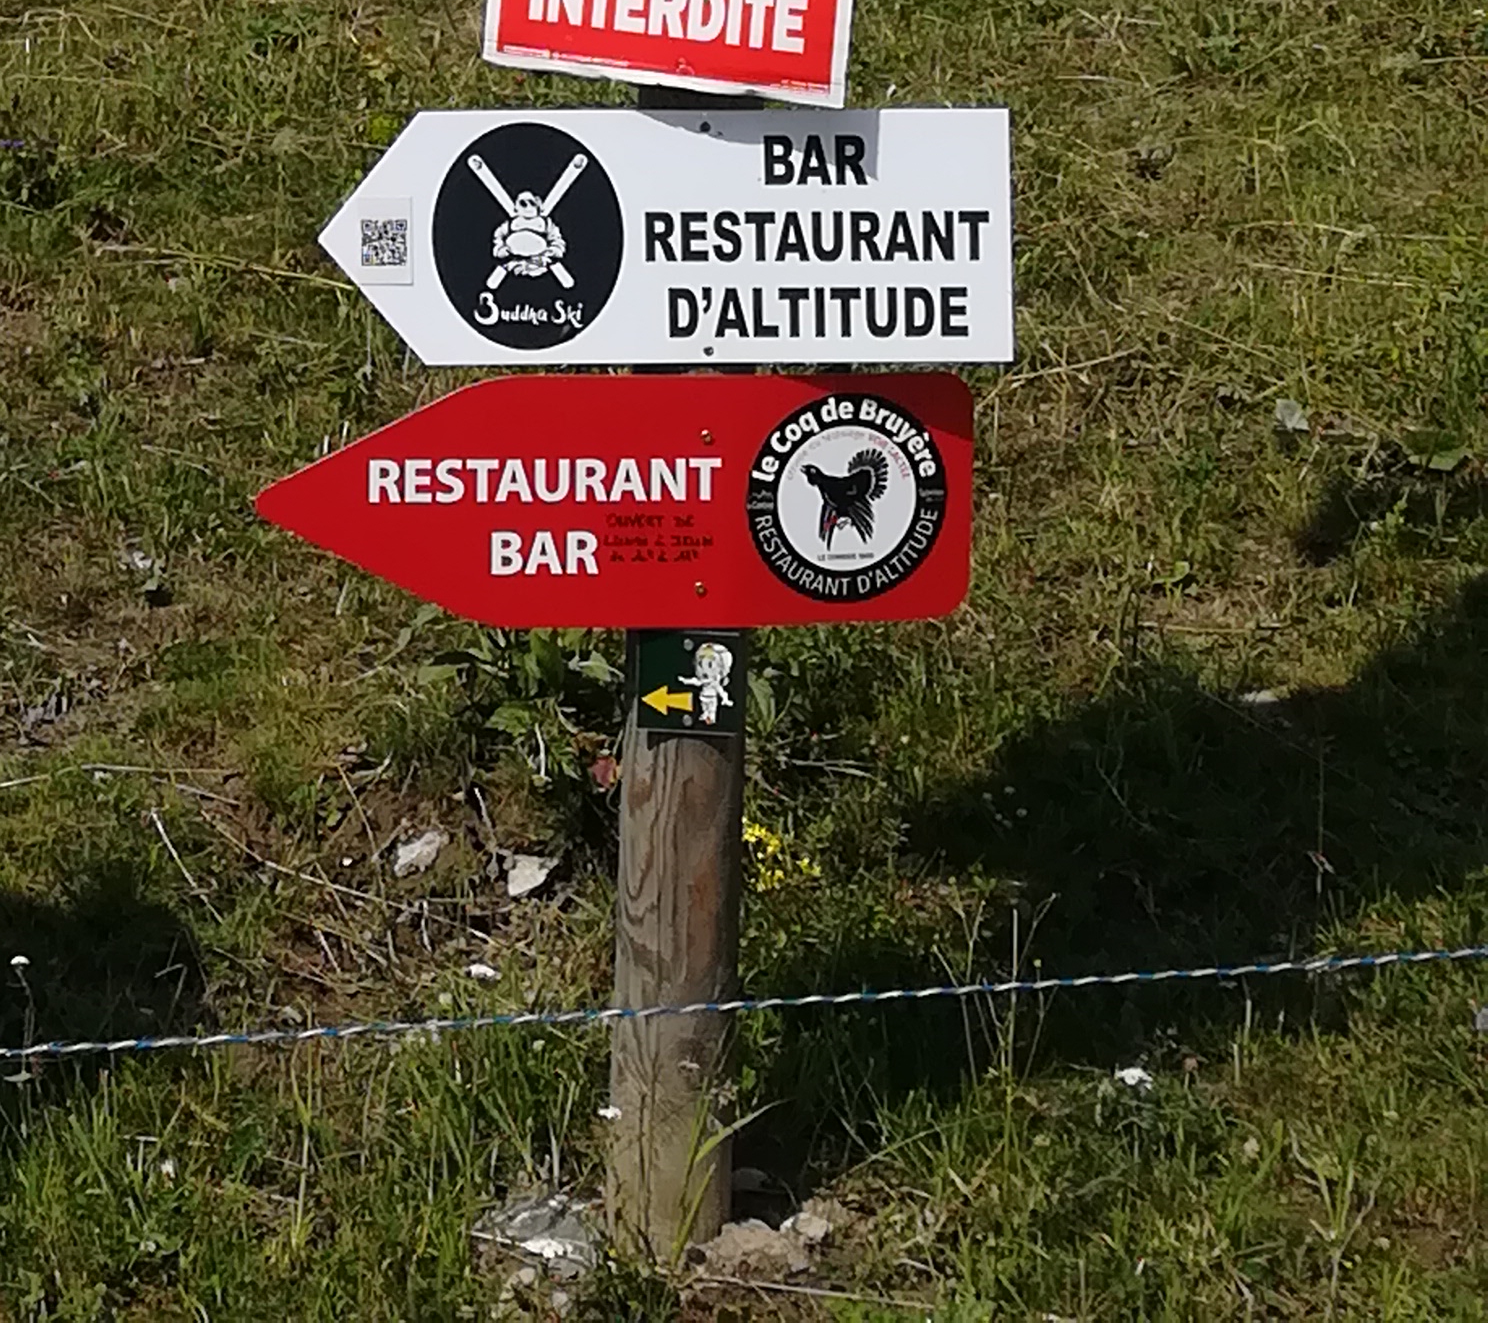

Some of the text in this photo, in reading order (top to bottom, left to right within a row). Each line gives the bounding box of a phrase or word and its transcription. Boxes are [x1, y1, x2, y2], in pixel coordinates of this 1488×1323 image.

[763, 135, 866, 186] BAR
[644, 211, 989, 262] RESTAURANT
[668, 287, 968, 338] D'ALTITUDE
[752, 456, 780, 482] le
[770, 411, 820, 454] Coq
[821, 397, 854, 422] de
[859, 399, 936, 478] Bruyère
[369, 458, 721, 503] RESTAURANT
[491, 531, 598, 575] BAR
[755, 508, 938, 595] RESTAURANT D'ALTITUDE
